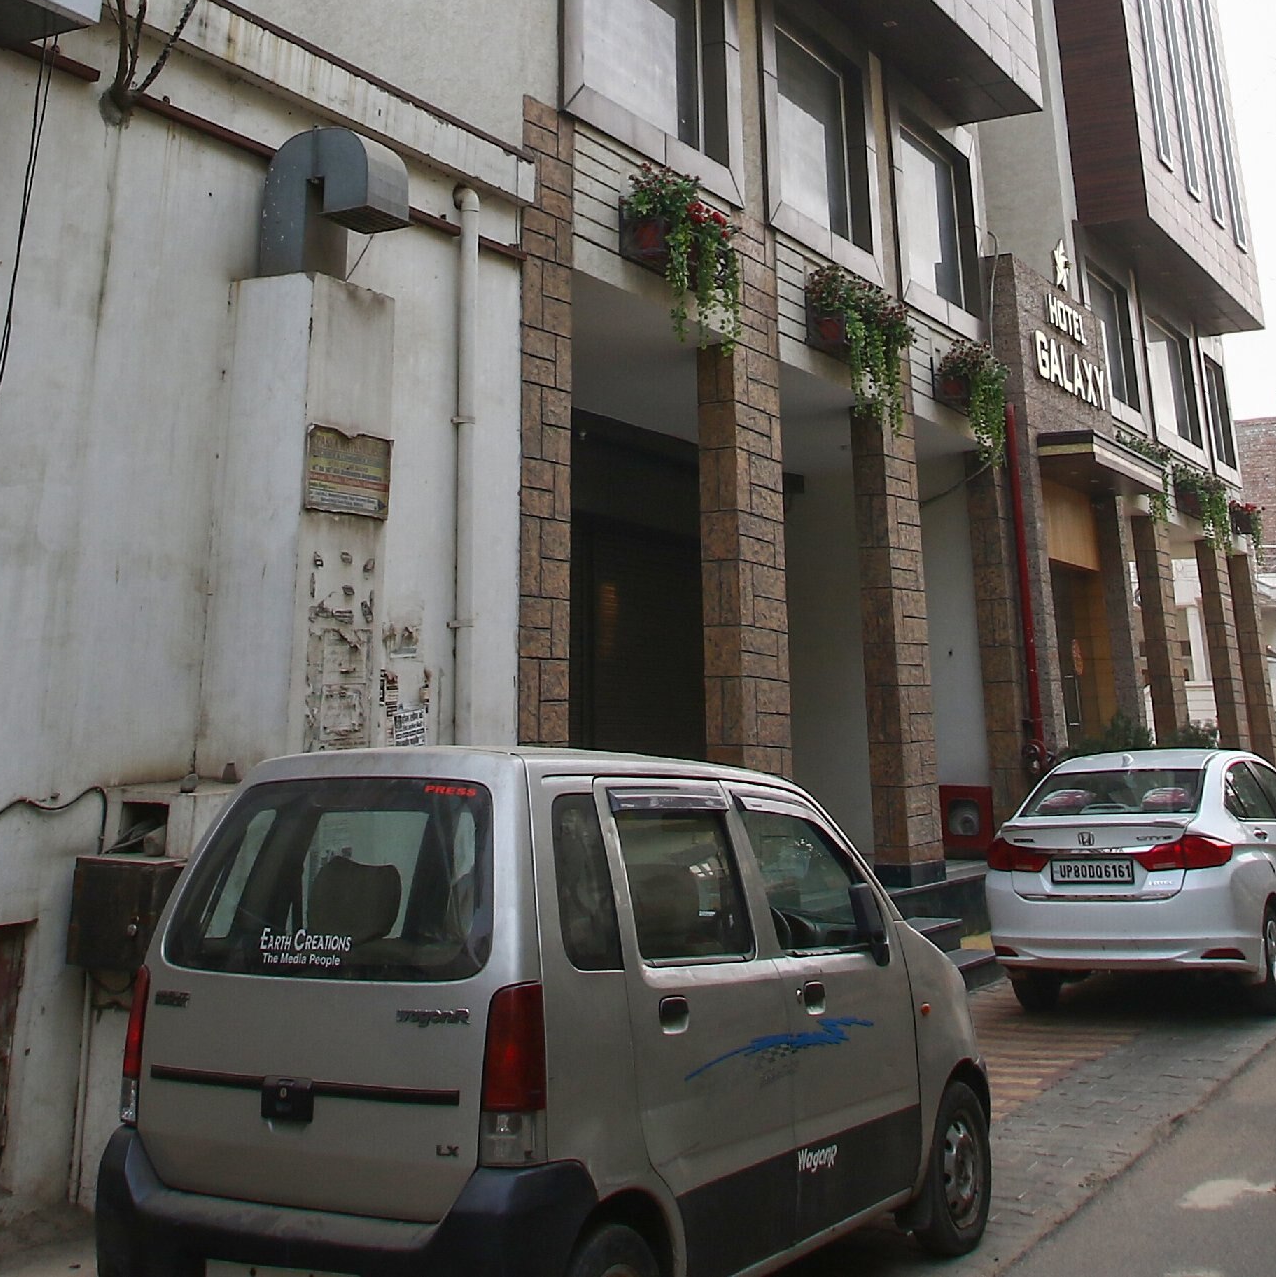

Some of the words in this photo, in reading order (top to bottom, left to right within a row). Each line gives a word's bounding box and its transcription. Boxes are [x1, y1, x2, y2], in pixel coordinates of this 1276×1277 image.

[1046, 293, 1087, 346] HOTEL
[1034, 329, 1106, 411] GALAXY
[424, 785, 477, 797] PRESS
[260, 927, 292, 951] EARTH
[294, 928, 353, 952] CREATIONS
[263, 952, 279, 965] The
[280, 952, 308, 965] Media
[309, 953, 341, 968] People
[435, 1144, 459, 1157] LX
[797, 1144, 838, 1173] WagonR
